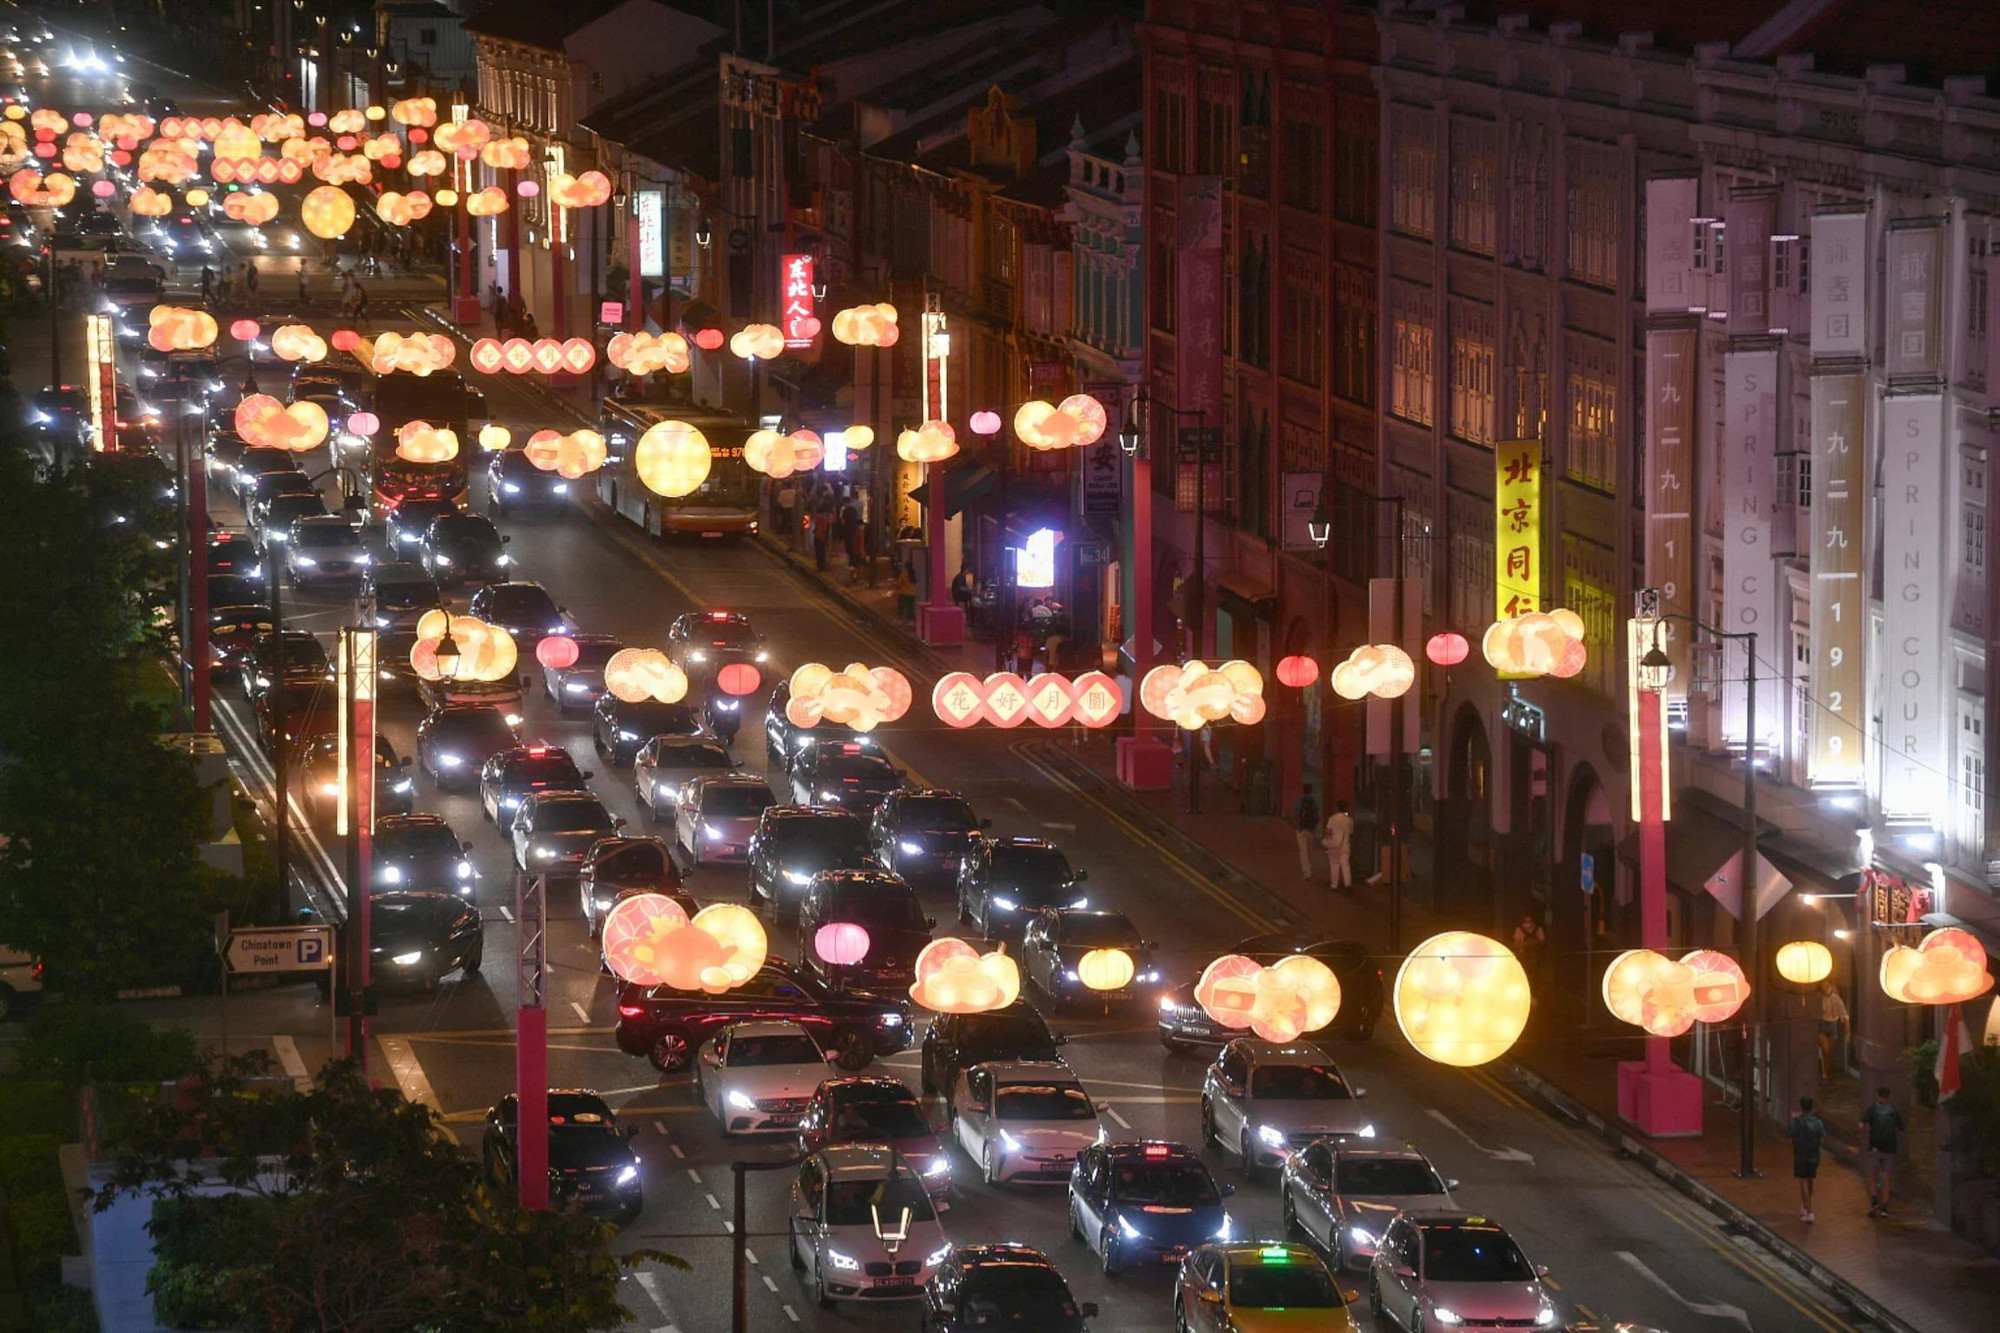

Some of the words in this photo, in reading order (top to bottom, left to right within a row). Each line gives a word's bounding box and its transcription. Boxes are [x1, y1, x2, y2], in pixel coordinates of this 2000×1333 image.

[1741, 373, 1758, 545] SPRING
[1827, 399, 1848, 550] 一九二九
[1902, 417, 1921, 603] SPRING
[951, 691, 1105, 711] 花好月圆
[1830, 602, 1845, 756] 1929
[1902, 635, 1920, 785] COURT
[241, 940, 291, 951] Chinatown
[254, 955, 279, 966] Point
[301, 941, 319, 961] P
